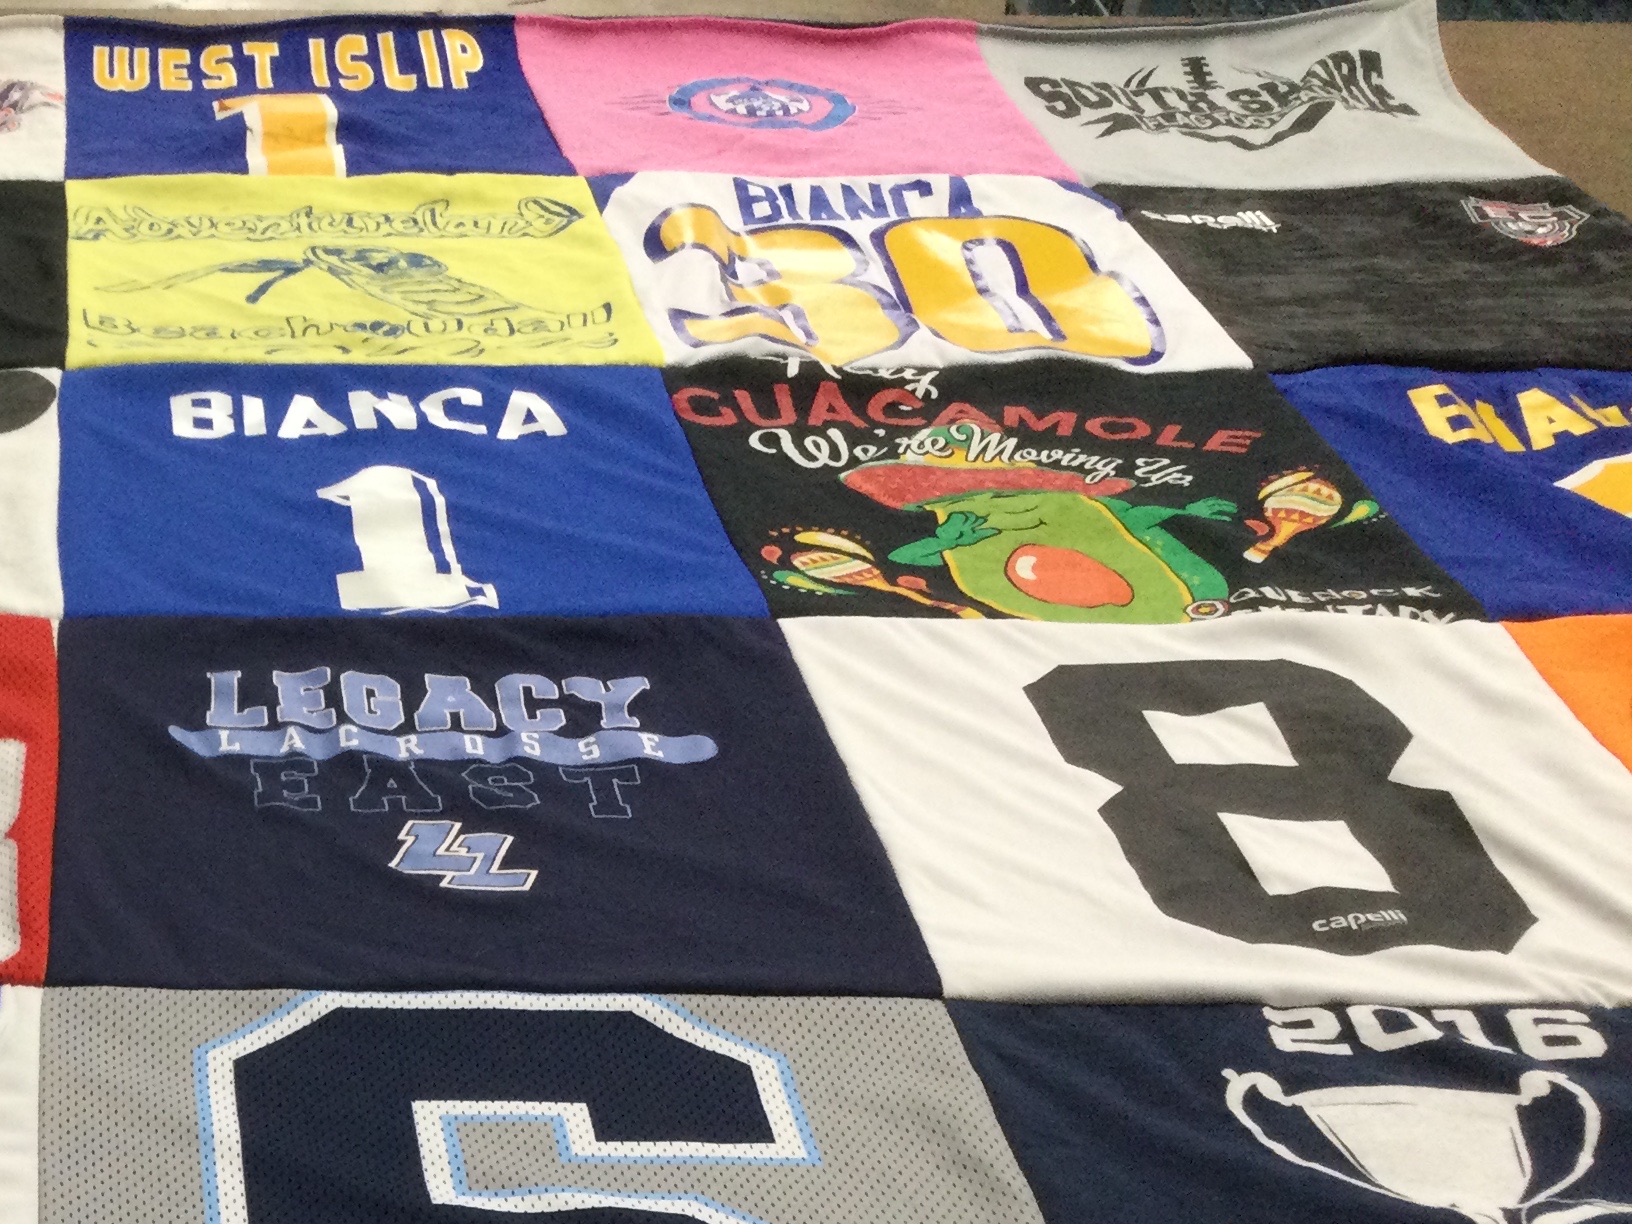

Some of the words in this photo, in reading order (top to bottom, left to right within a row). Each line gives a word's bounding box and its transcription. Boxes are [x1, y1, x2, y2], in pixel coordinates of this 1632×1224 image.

[93, 42, 279, 90] WEST
[308, 29, 483, 93] ISLIP
[1024, 76, 1221, 118] SOUTH
[213, 93, 346, 177] 1
[168, 386, 569, 441] BIANCA
[671, 380, 1262, 454] GUACAMOLE
[948, 422, 1118, 482] Moving
[316, 465, 500, 615] 1
[206, 666, 651, 732] LEGACY
[217, 724, 665, 760] LACROSSE
[250, 756, 641, 820] EAST
[1022, 657, 1540, 957] 8
[1311, 909, 1408, 932] capelli
[1261, 1004, 1609, 1060] 2016
